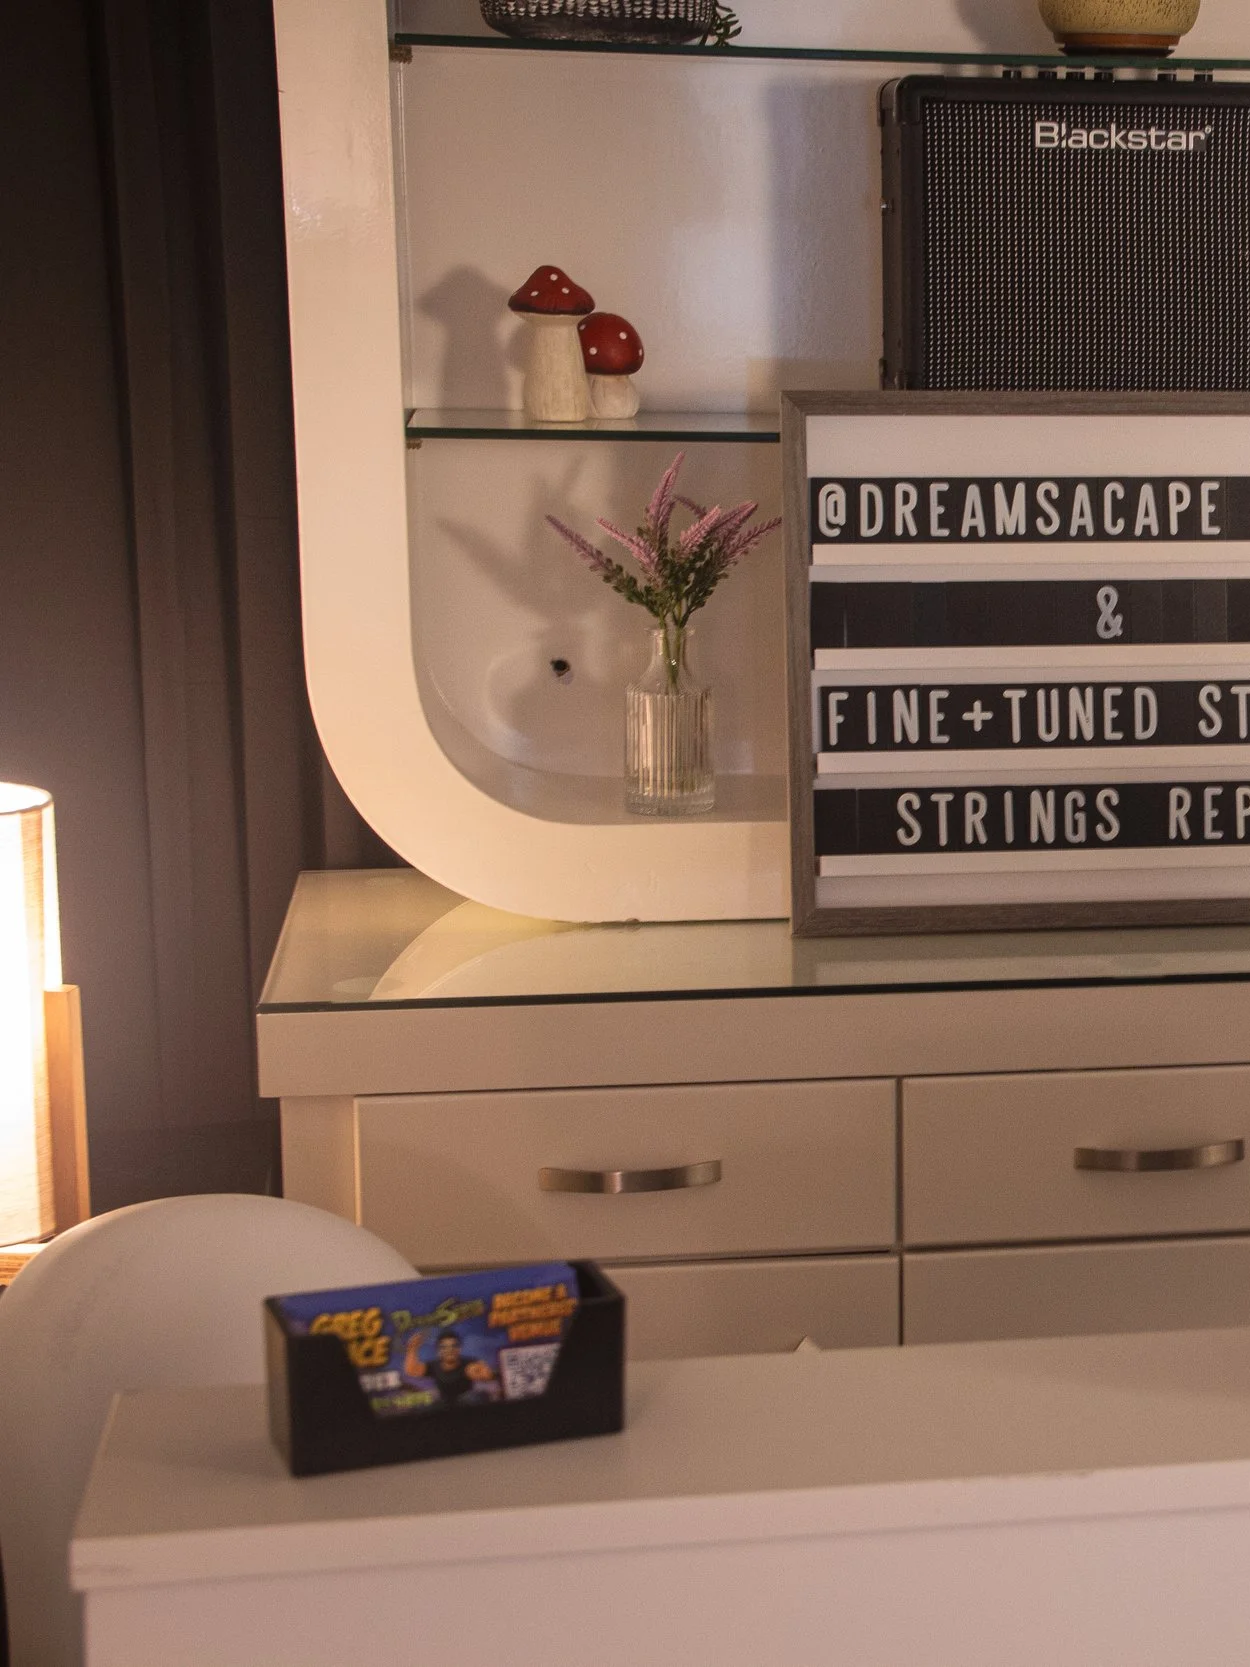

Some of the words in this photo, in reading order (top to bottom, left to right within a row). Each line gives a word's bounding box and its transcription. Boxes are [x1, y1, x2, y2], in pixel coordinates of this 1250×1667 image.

[1035, 121, 1206, 150] Blackstar
[818, 480, 1221, 537] @DREAMSACAPE
[1096, 585, 1123, 639] &
[827, 685, 1158, 746] FINE+TUNED
[896, 786, 1121, 846] STRINGS
